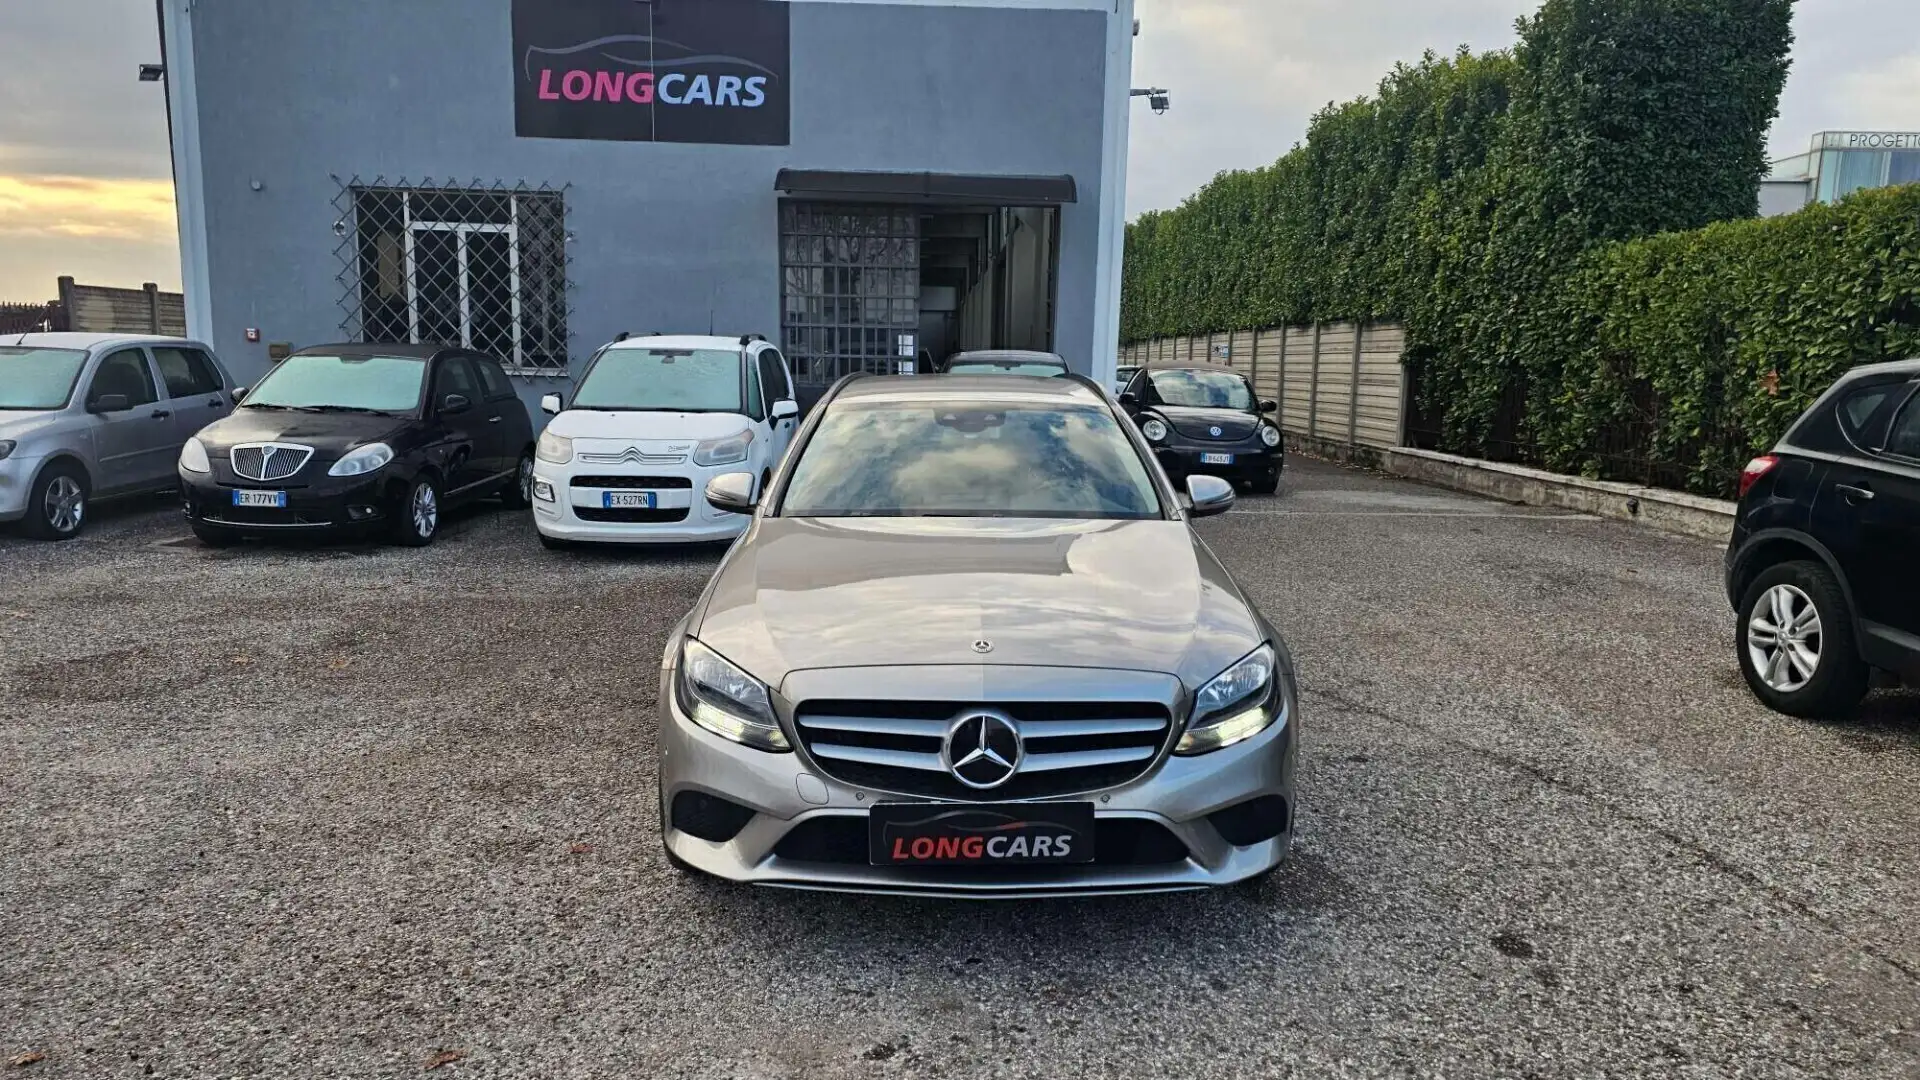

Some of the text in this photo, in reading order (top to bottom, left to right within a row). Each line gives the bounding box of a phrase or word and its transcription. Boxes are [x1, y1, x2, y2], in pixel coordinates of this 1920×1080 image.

[538, 69, 767, 107] LONGCARS
[1849, 133, 1920, 148] PROGETT
[240, 493, 278, 504] ER 177VV
[611, 495, 648, 506] EX 527RN
[892, 835, 1072, 860] LONGCARS
